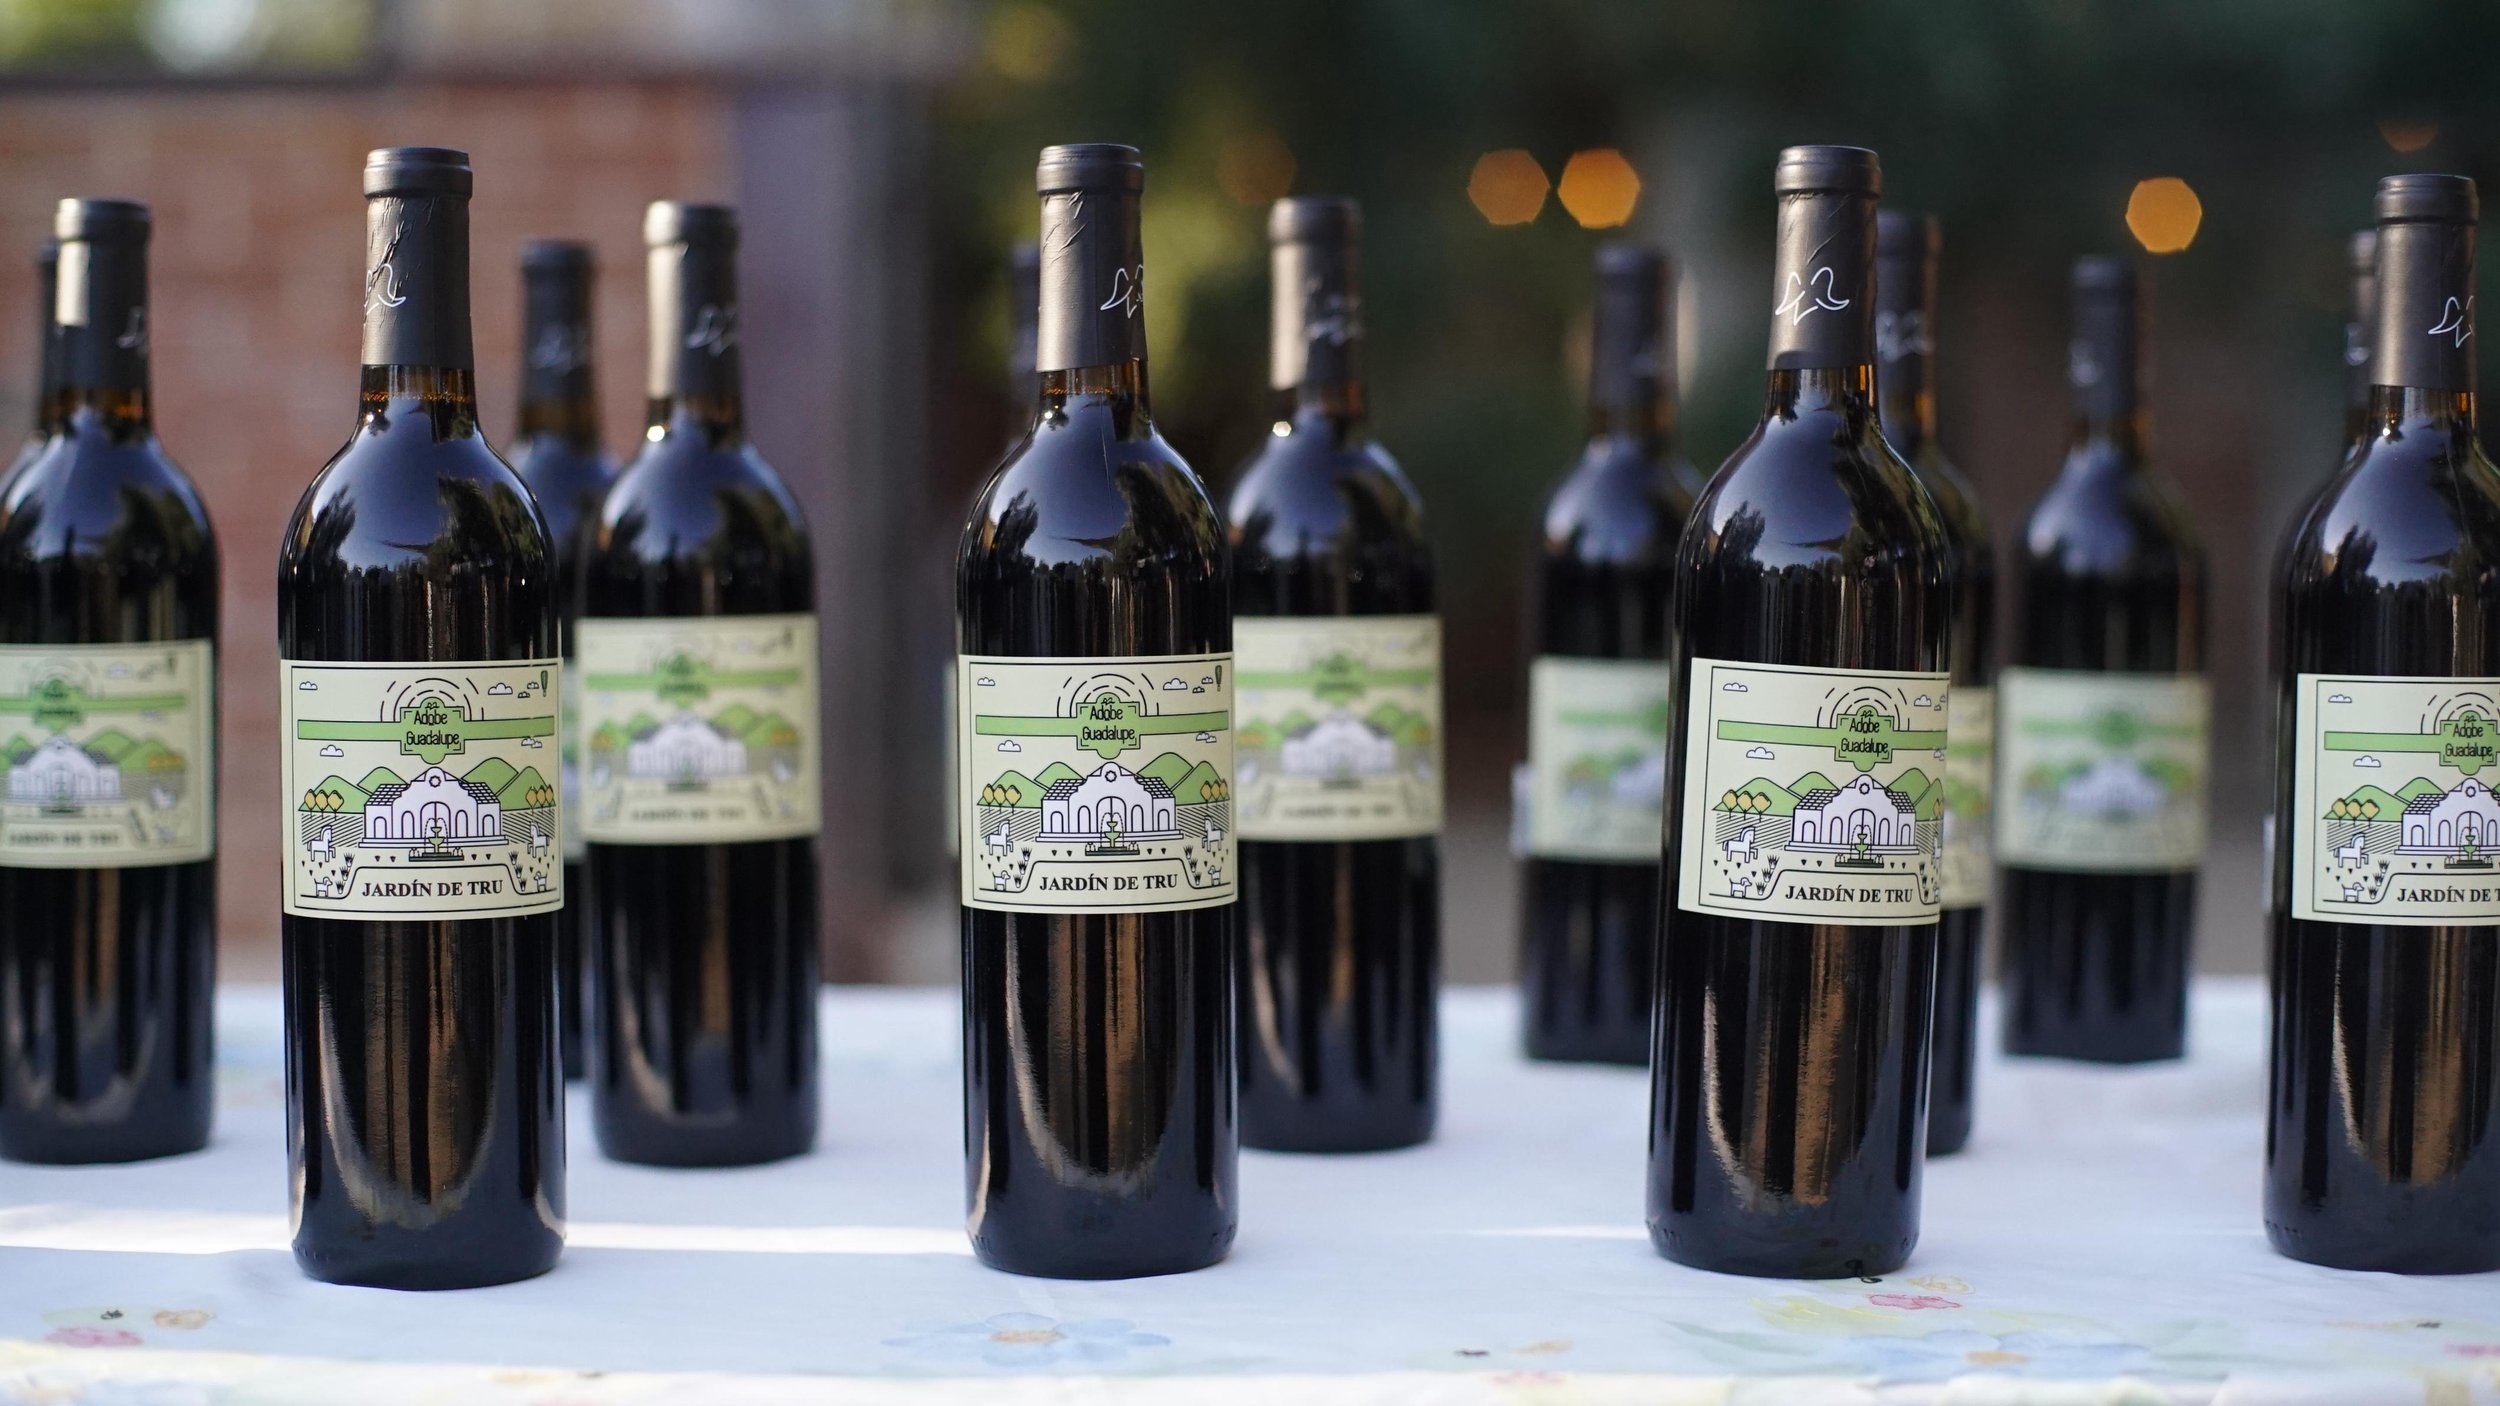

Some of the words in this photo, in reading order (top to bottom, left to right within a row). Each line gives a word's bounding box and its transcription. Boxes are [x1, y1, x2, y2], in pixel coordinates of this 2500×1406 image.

[414, 710, 447, 725] Adobe
[1090, 705, 1123, 720] Adobe
[1849, 717, 1880, 733] Adobe
[2452, 723, 2483, 738] Adobe
[406, 731, 460, 749] Guadalupe
[1082, 726, 1135, 744] Guadalupe
[1841, 738, 1888, 756] Guadalupe
[2445, 744, 2493, 760] Guadalupe
[362, 879, 431, 897] JARDÍN
[437, 883, 463, 896] DE
[468, 880, 503, 895] TRU
[1040, 873, 1108, 891] JARDÍN
[1113, 876, 1139, 890] DE
[1142, 874, 1178, 888] TRU
[1785, 885, 1854, 902] JARDÍN
[1859, 889, 1881, 902] DE
[1884, 889, 1913, 902] TRU
[2397, 886, 2465, 902] JARDÍN
[2470, 889, 2491, 902] DE
